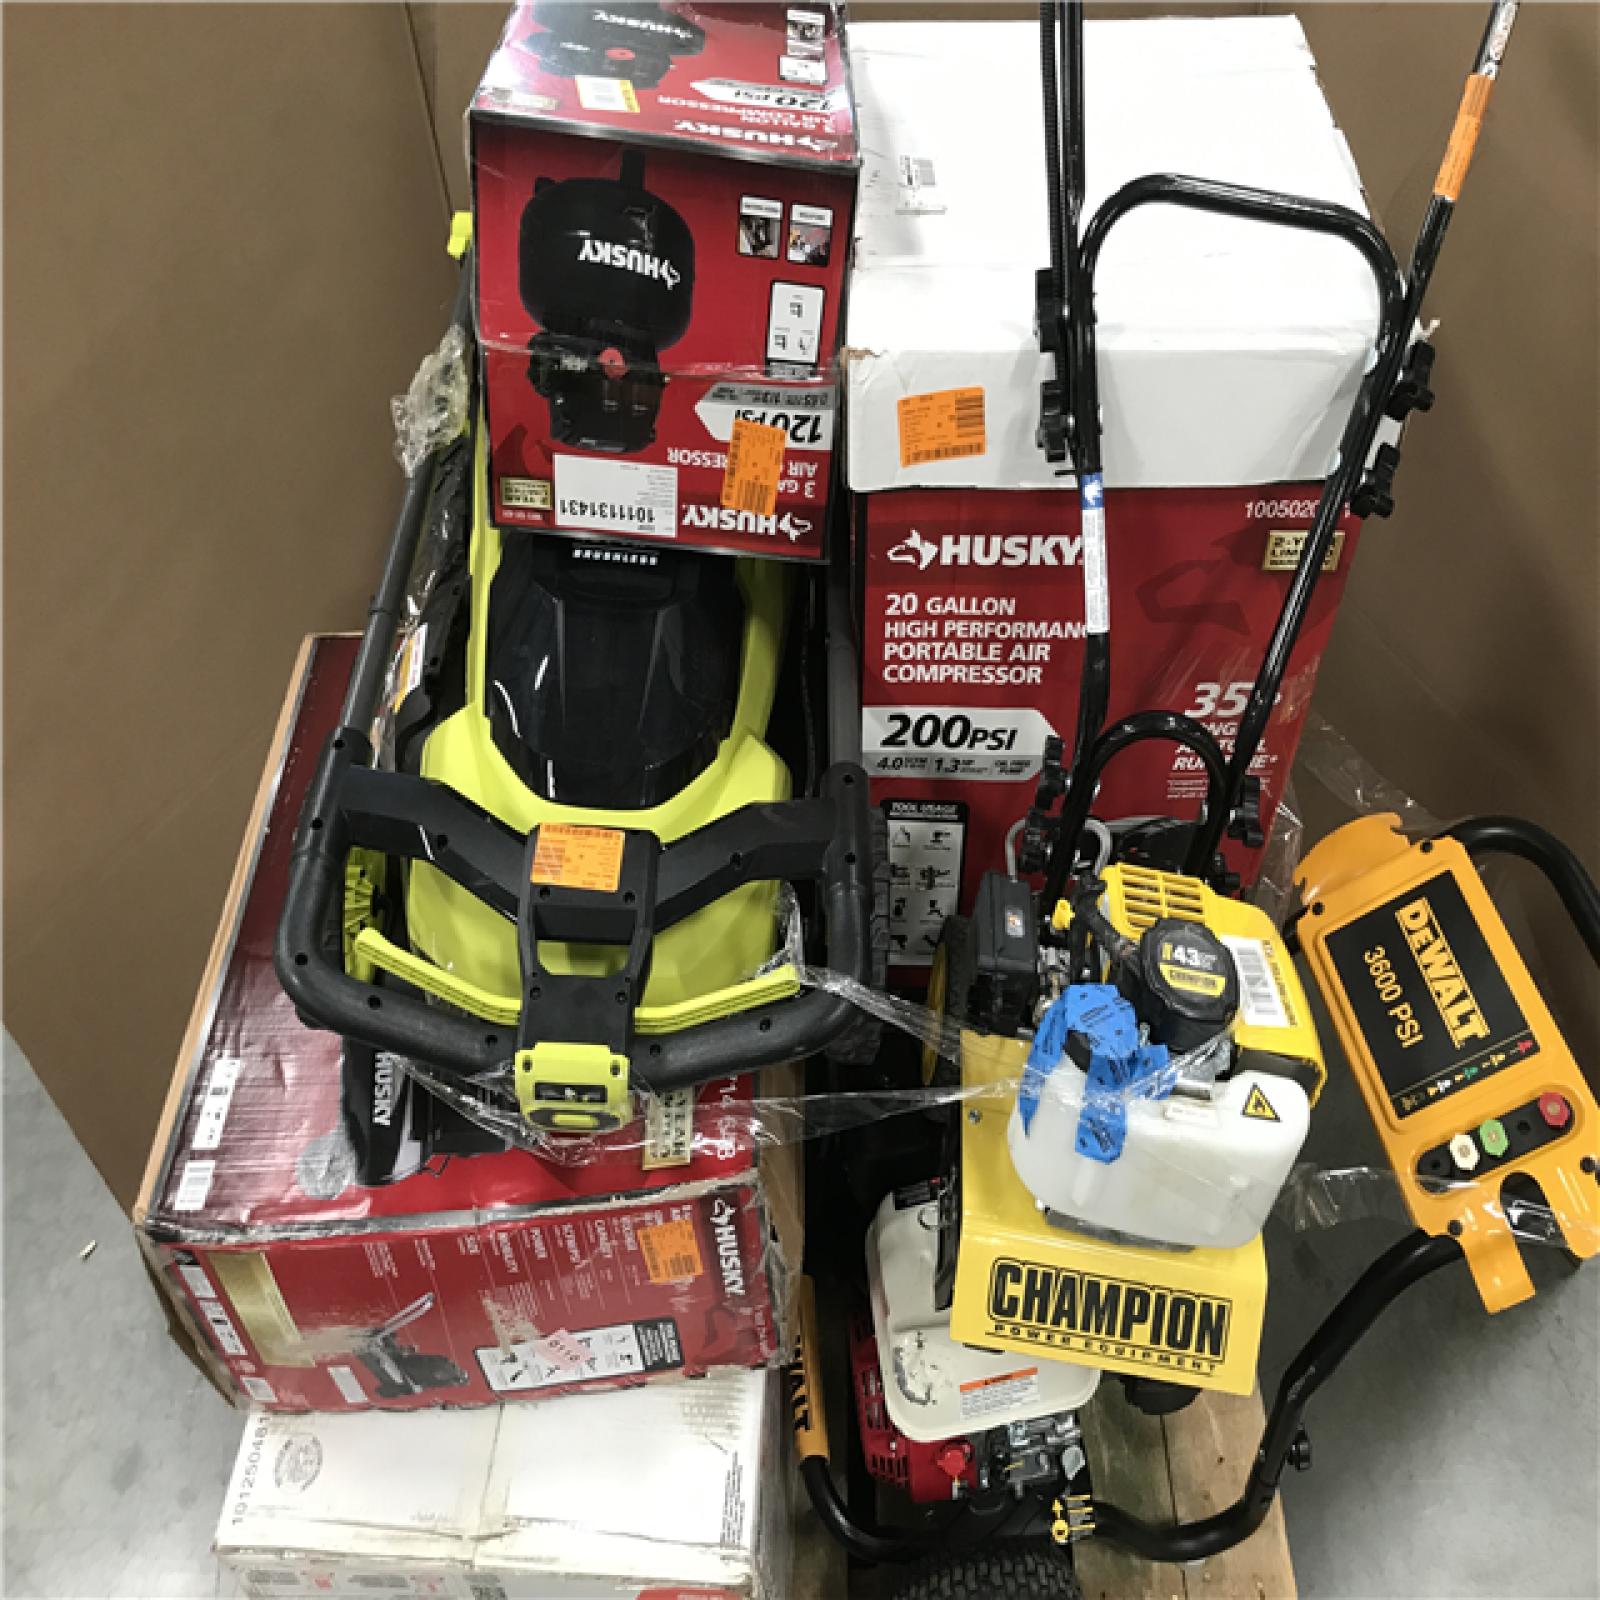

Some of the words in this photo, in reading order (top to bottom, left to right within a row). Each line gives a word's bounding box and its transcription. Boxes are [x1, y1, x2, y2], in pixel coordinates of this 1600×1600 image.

[673, 120, 796, 145] HUSKY
[577, 239, 659, 279] HUSKY
[788, 461, 818, 478] AIR
[559, 499, 656, 524] 1011131431
[682, 504, 778, 536] HUSKY
[940, 535, 1082, 566] HUSKY
[885, 593, 917, 616] 20
[926, 597, 1016, 616] GALLON
[884, 621, 937, 639] HIGH
[883, 643, 1001, 662] PORTABLE
[1009, 644, 1051, 662] AIR
[883, 665, 1042, 684] COMPRESSOR
[1387, 1000, 1424, 1048] PSI
[371, 1052, 393, 1126] HUSKY
[715, 1222, 746, 1296] HUSKY
[992, 1262, 1230, 1358] CHAMPION
[994, 1323, 1071, 1346] POWER
[1084, 1338, 1216, 1371] EQUIPMENT
